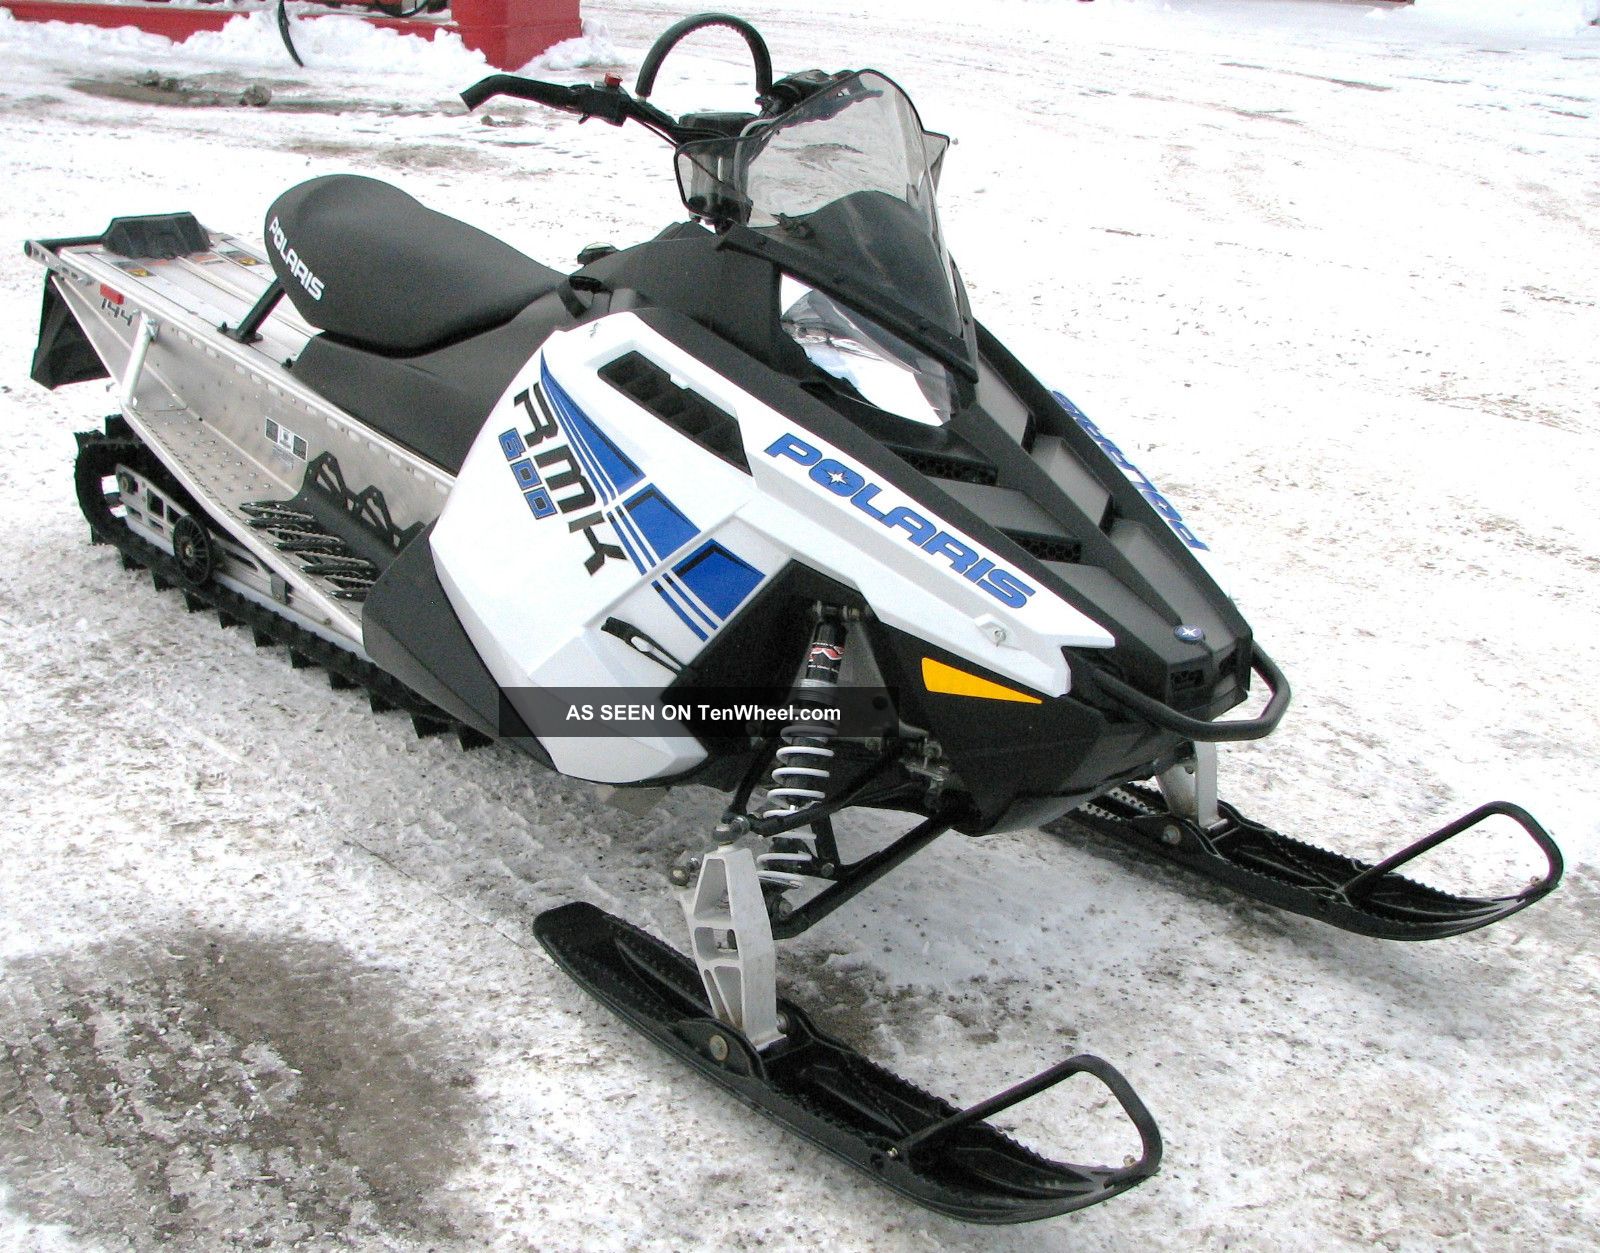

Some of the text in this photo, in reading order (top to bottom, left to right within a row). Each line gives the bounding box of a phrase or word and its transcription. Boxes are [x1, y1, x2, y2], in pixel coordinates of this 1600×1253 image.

[269, 216, 325, 301] POLARIS
[498, 427, 558, 520] 600
[513, 381, 628, 577] RMK
[764, 432, 1036, 609] POLARIS
